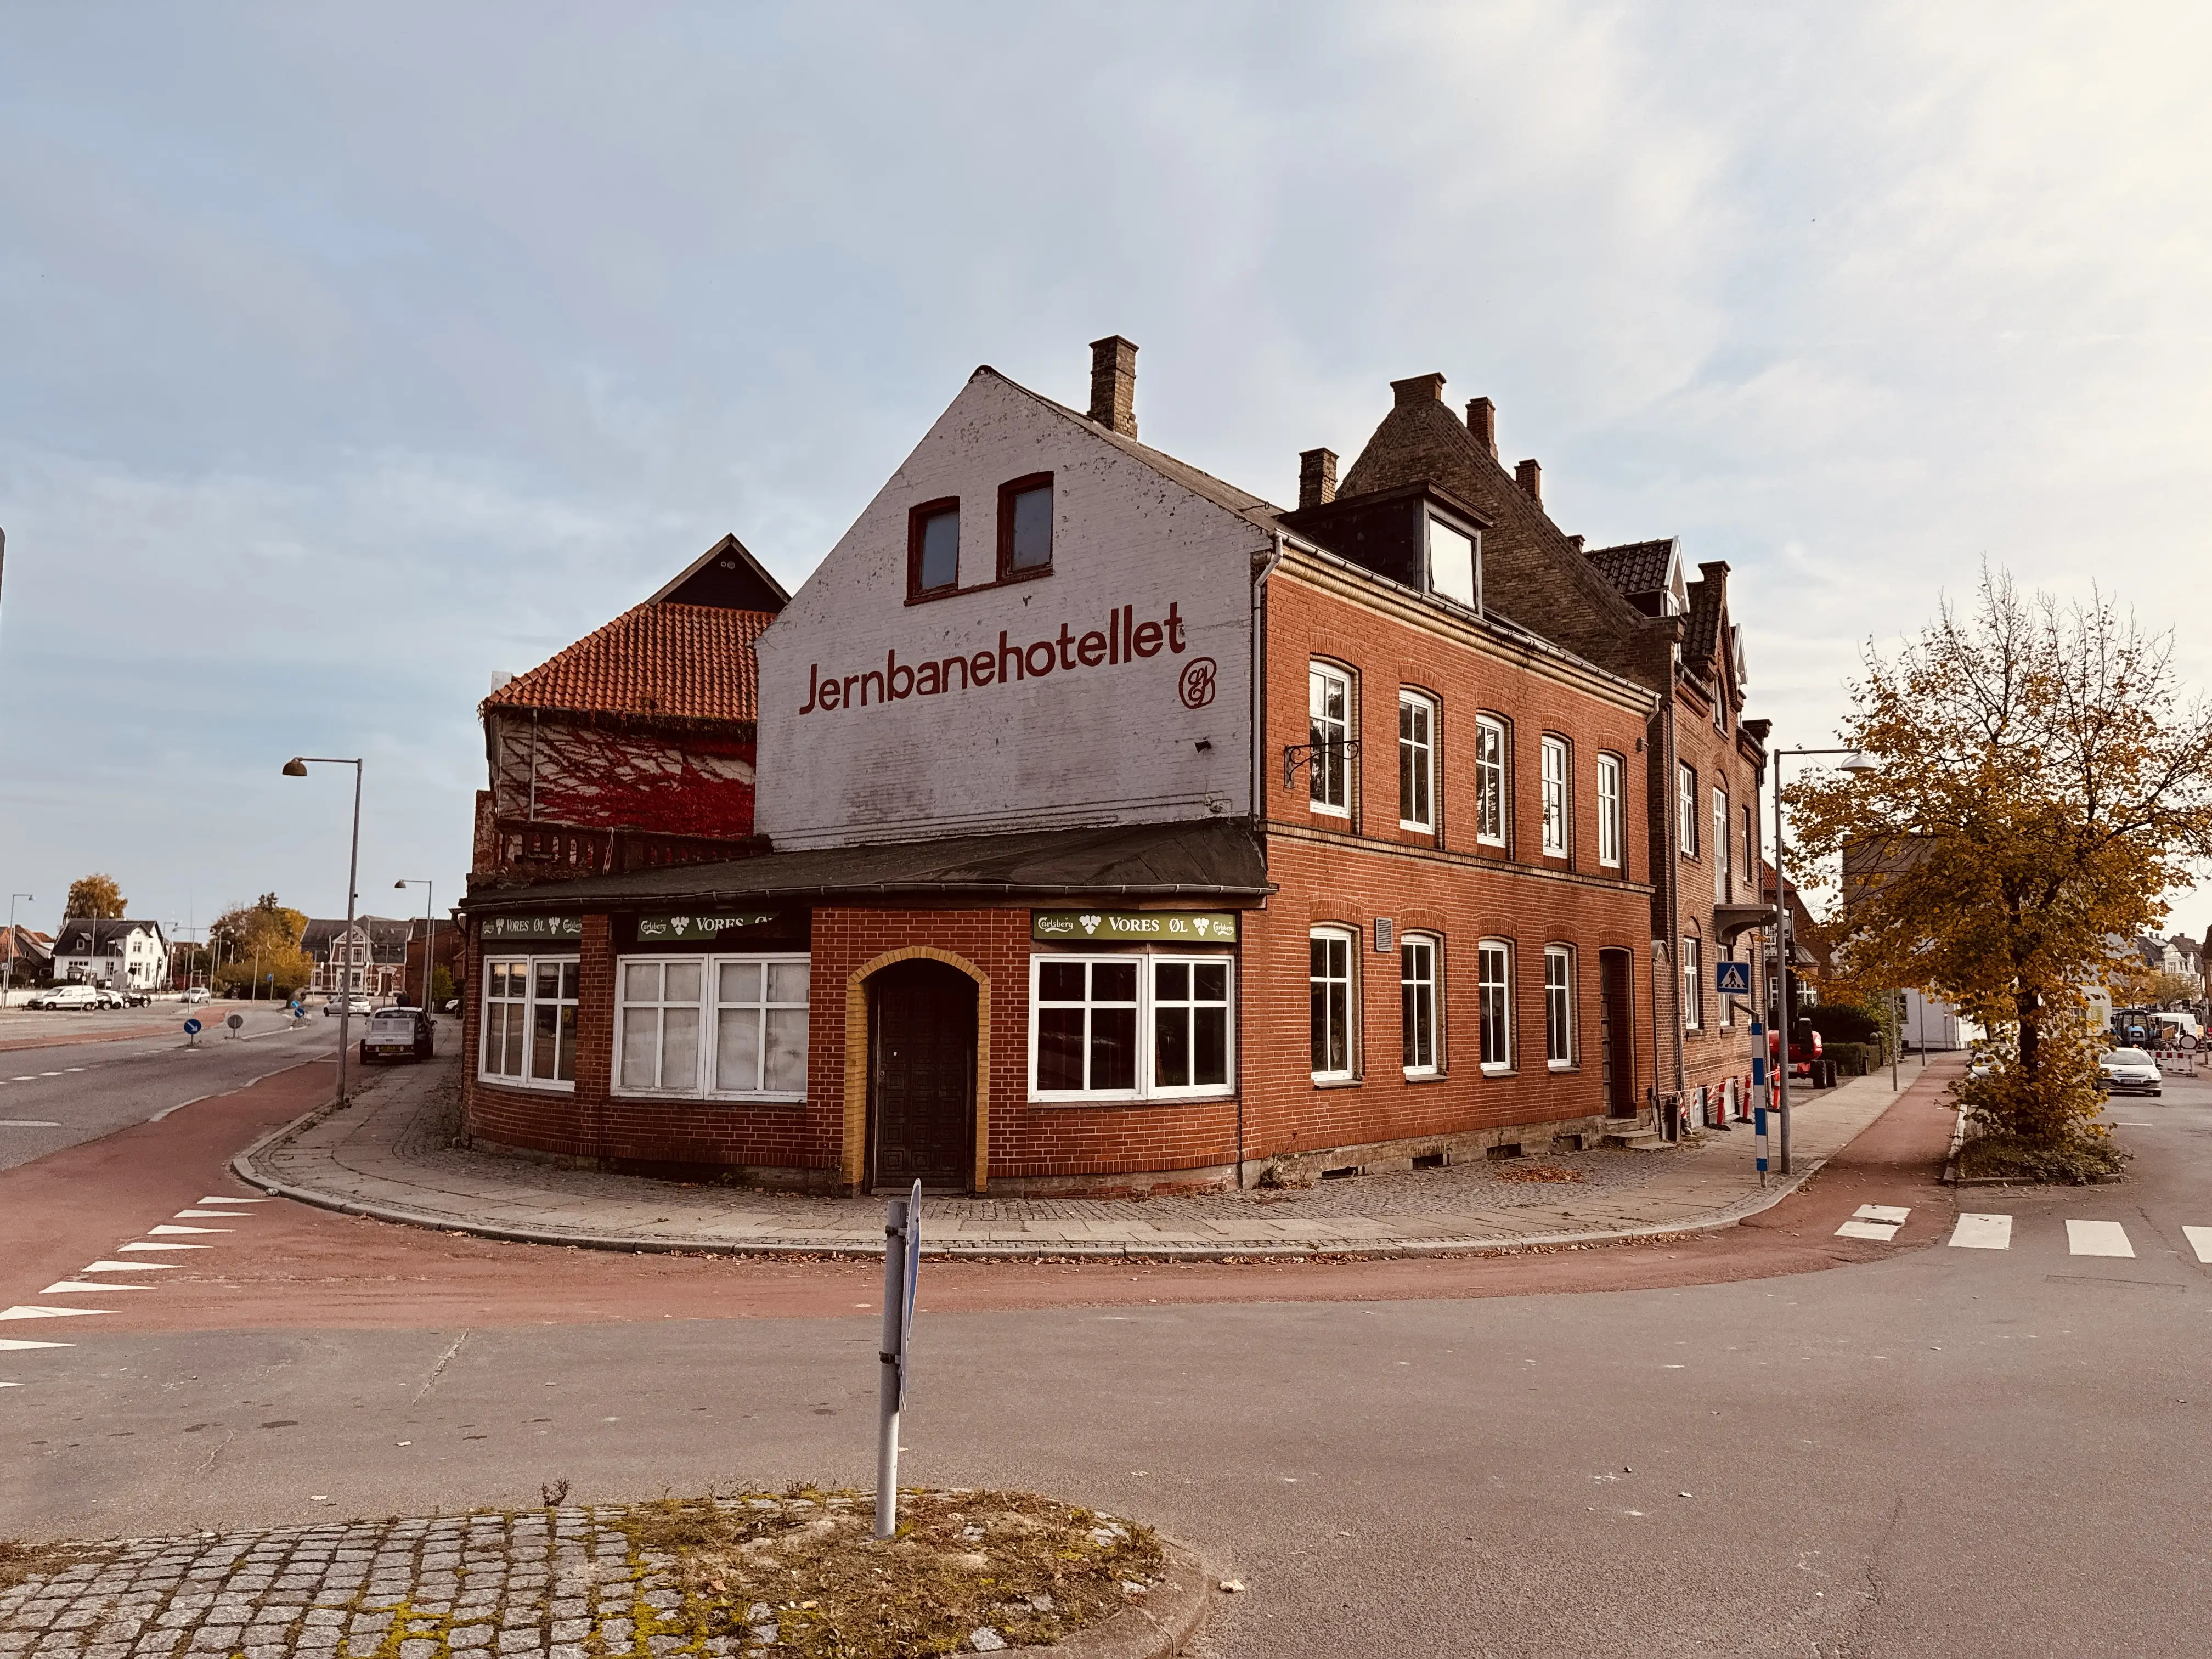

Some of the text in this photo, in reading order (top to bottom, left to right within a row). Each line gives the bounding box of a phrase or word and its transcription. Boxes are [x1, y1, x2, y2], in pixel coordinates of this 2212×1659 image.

[799, 601, 1186, 715] Jernbanehotellet
[507, 919, 529, 932] VORES
[533, 918, 545, 932] ØL
[641, 919, 666, 934] Carlsberg
[696, 917, 744, 932] VORES
[1038, 917, 1234, 935] Carlsberg VORES ØL Carlsberg
